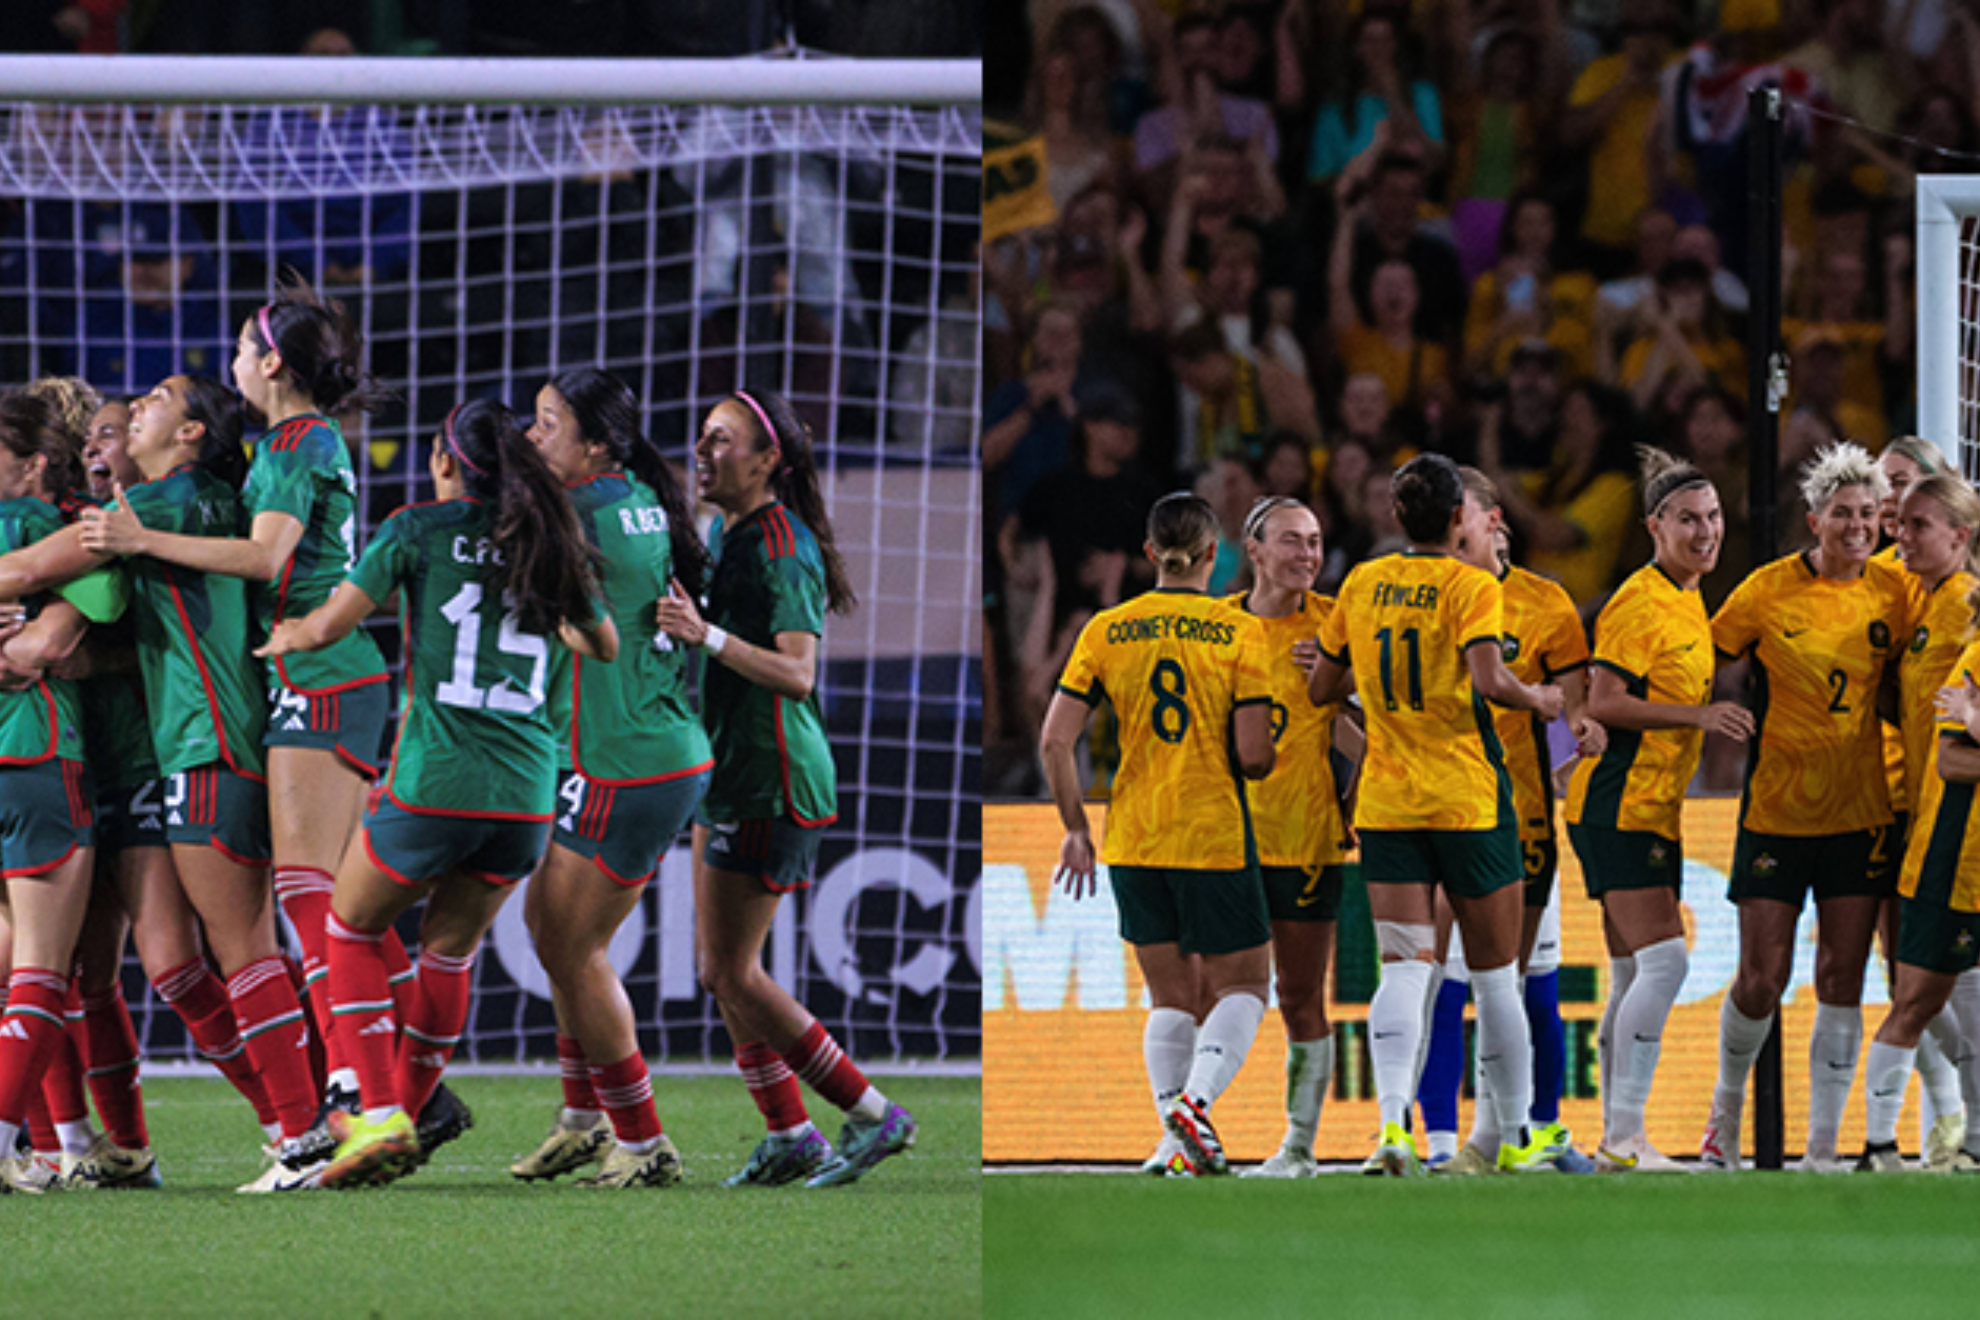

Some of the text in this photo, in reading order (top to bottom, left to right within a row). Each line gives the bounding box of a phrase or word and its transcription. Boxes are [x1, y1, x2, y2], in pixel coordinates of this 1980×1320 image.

[437, 581, 548, 714] 15
[1374, 627, 1424, 711] 11
[1151, 657, 1190, 744] 8
[1828, 669, 1850, 713] 2
